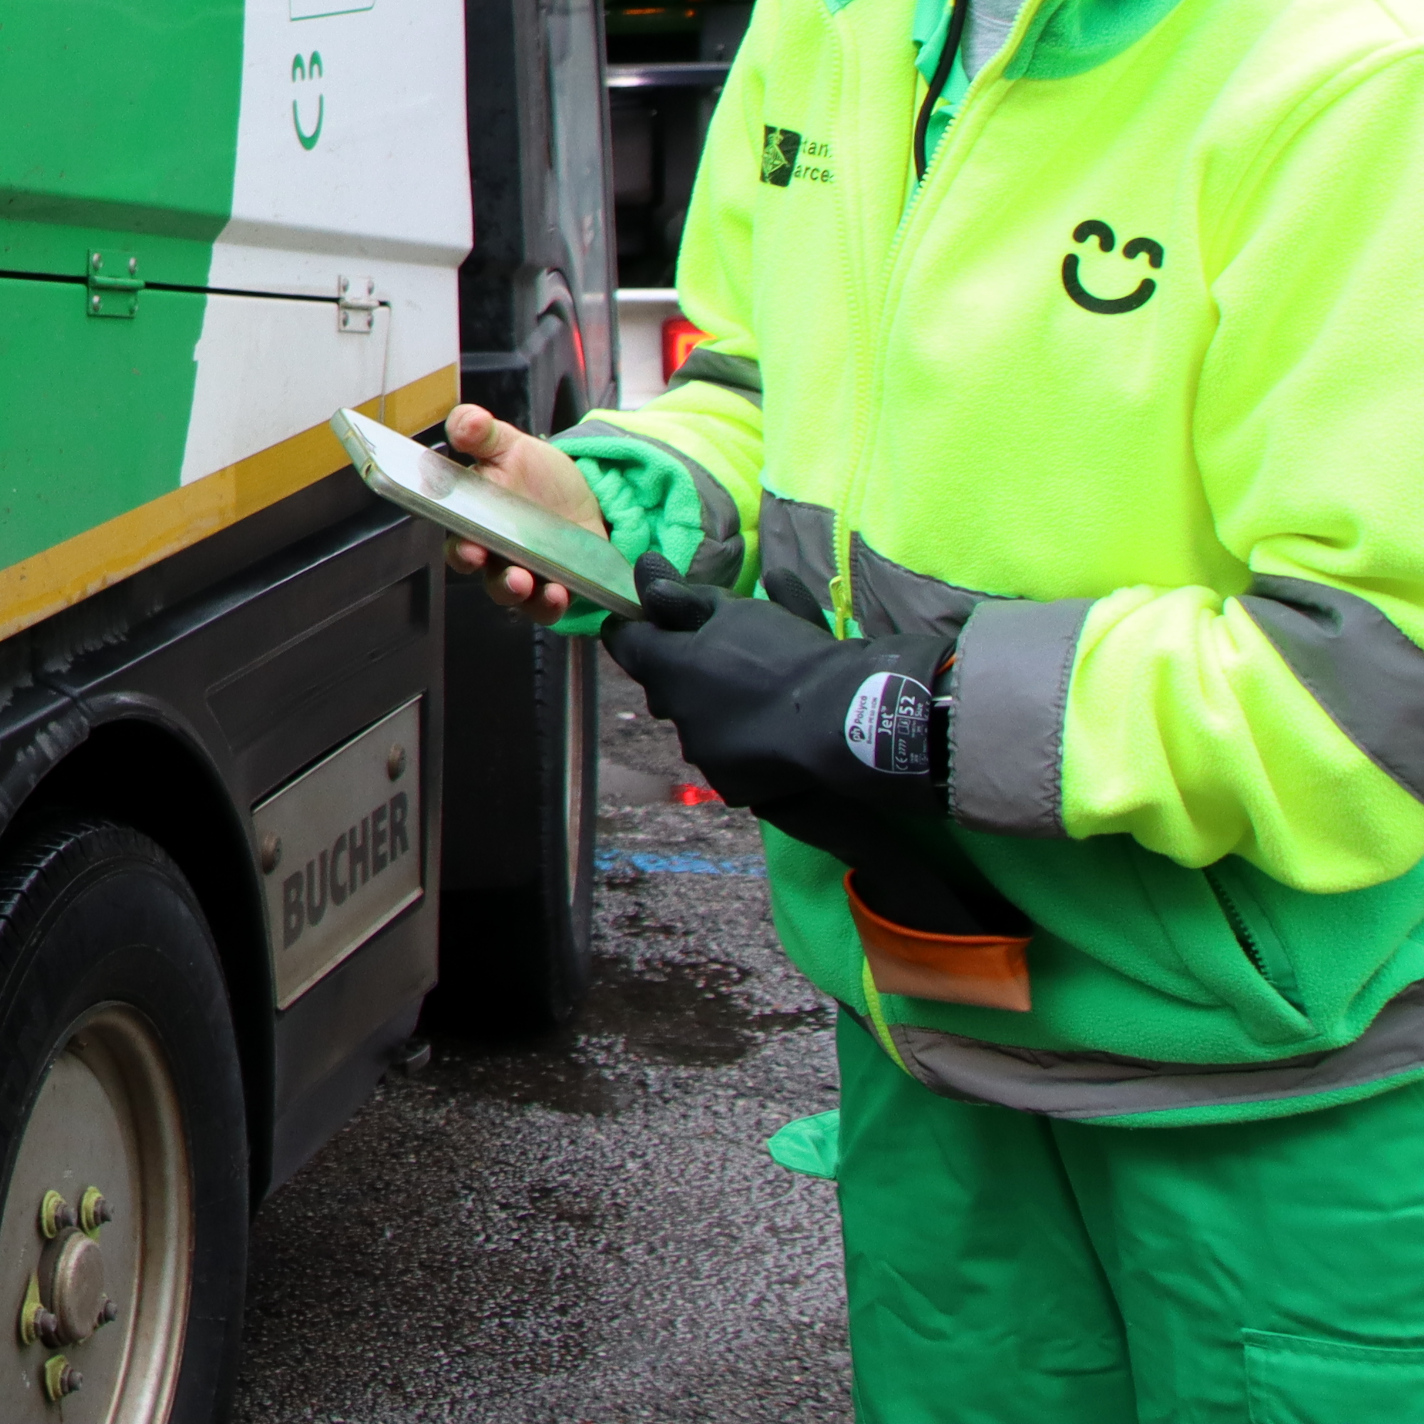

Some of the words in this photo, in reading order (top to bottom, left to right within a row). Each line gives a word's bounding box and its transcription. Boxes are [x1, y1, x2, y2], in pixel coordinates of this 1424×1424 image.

[855, 695, 867, 724] Polyco
[899, 696, 915, 716] 52
[283, 791, 409, 950] BUCHER
